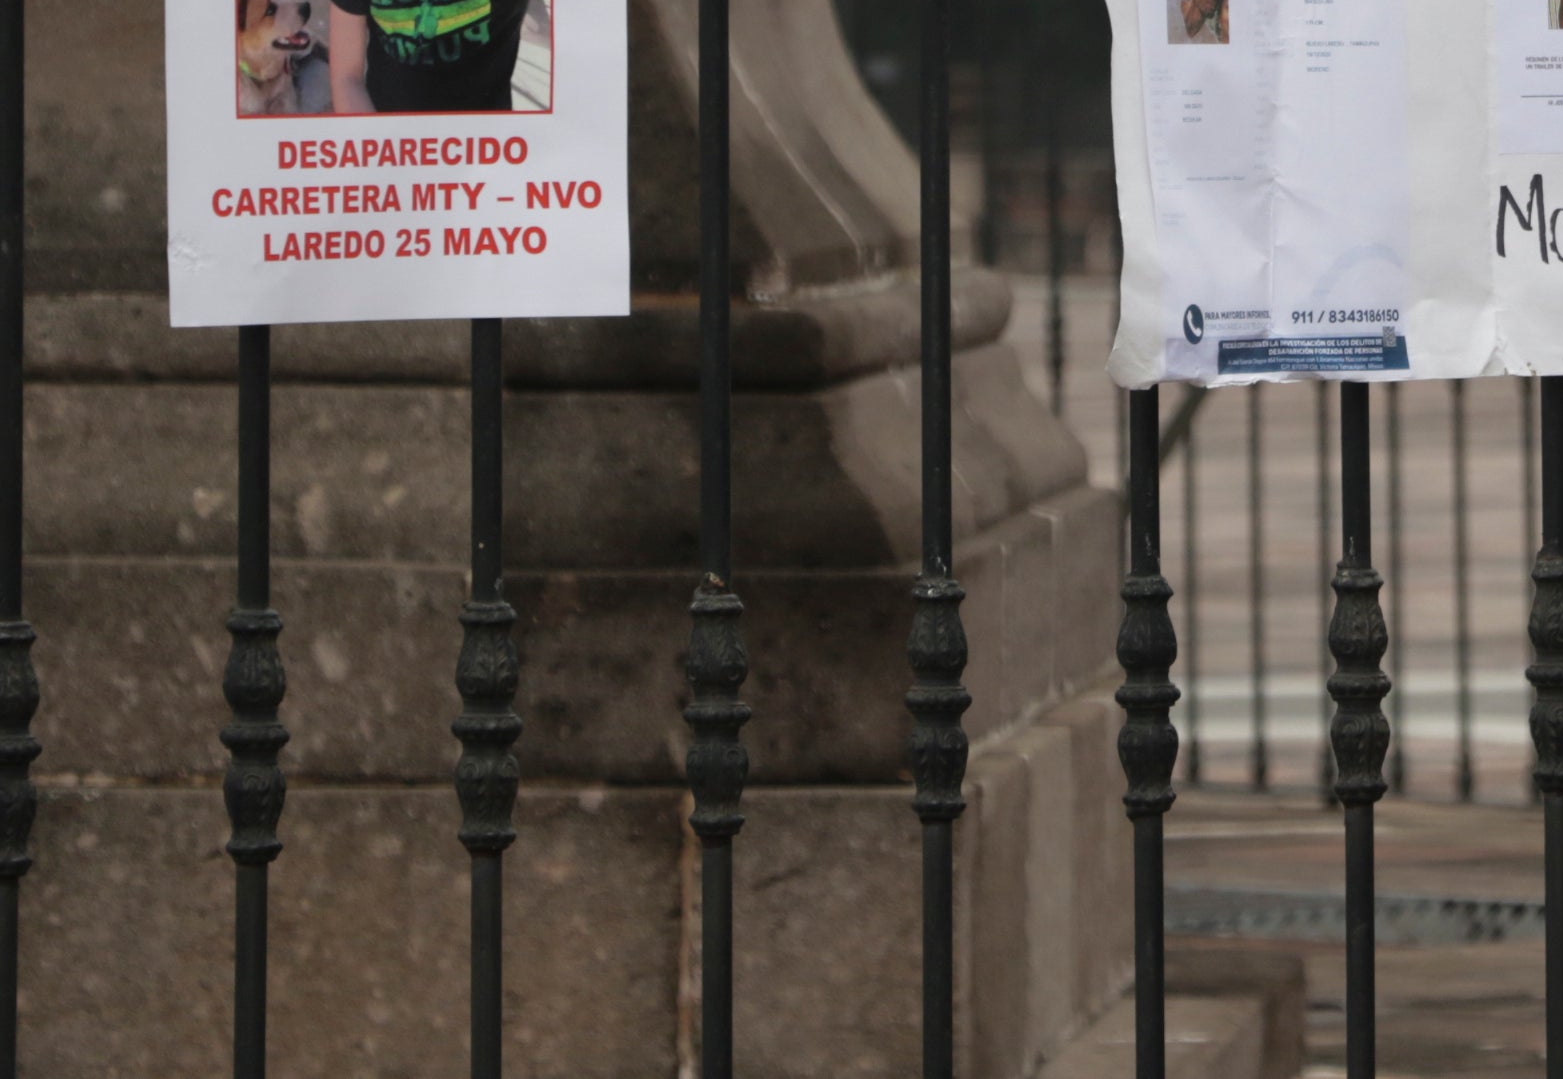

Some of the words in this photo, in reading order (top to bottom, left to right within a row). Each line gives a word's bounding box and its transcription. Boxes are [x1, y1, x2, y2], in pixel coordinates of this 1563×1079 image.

[278, 137, 529, 169] DESAPARECIDO
[211, 184, 402, 217] CARRETERA
[411, 182, 486, 211] MTY
[526, 180, 602, 210] NVO
[263, 229, 385, 261] LAREDO
[395, 228, 431, 258] 25
[443, 226, 547, 257] MAYO
[1292, 311, 1313, 323] 911
[1317, 310, 1325, 323] /
[1329, 309, 1400, 323] 8343186150
